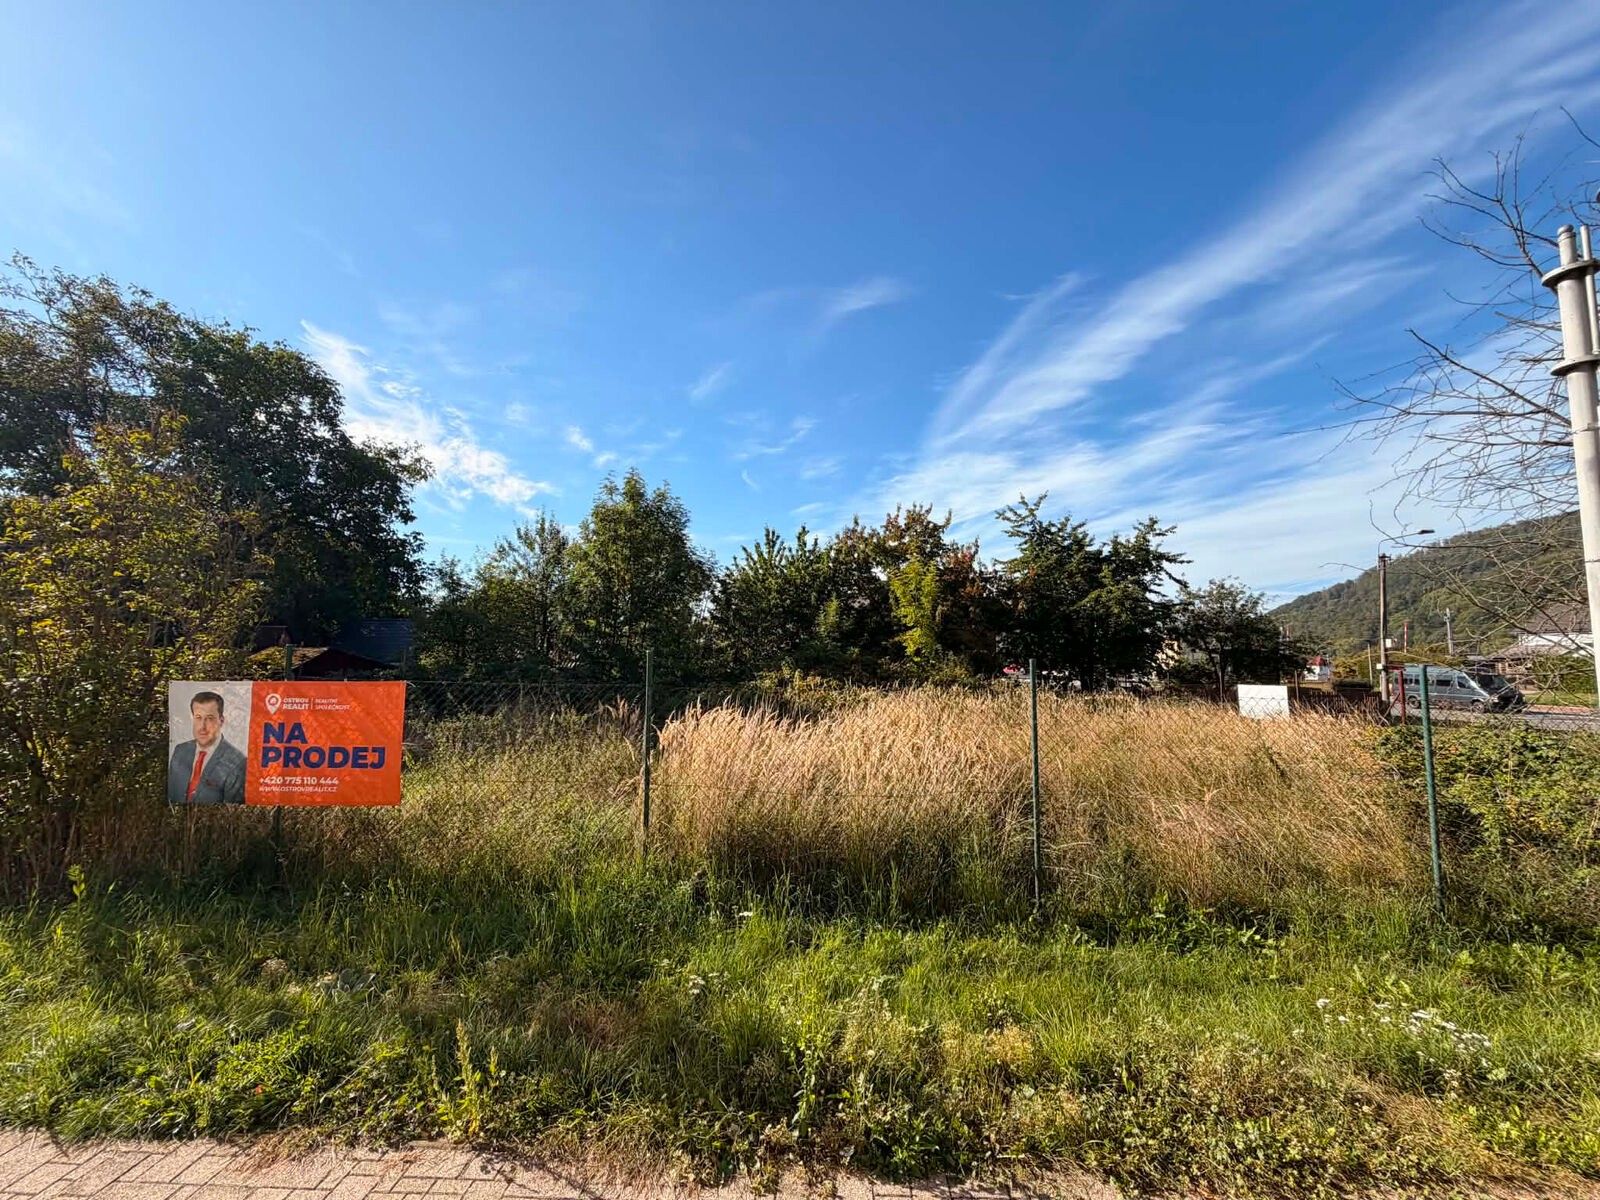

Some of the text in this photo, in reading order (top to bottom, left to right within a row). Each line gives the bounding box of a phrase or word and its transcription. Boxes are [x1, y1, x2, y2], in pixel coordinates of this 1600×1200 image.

[263, 722, 308, 744] NA
[261, 746, 386, 769] PRODEJ
[259, 776, 339, 785] +420 775 110 444
